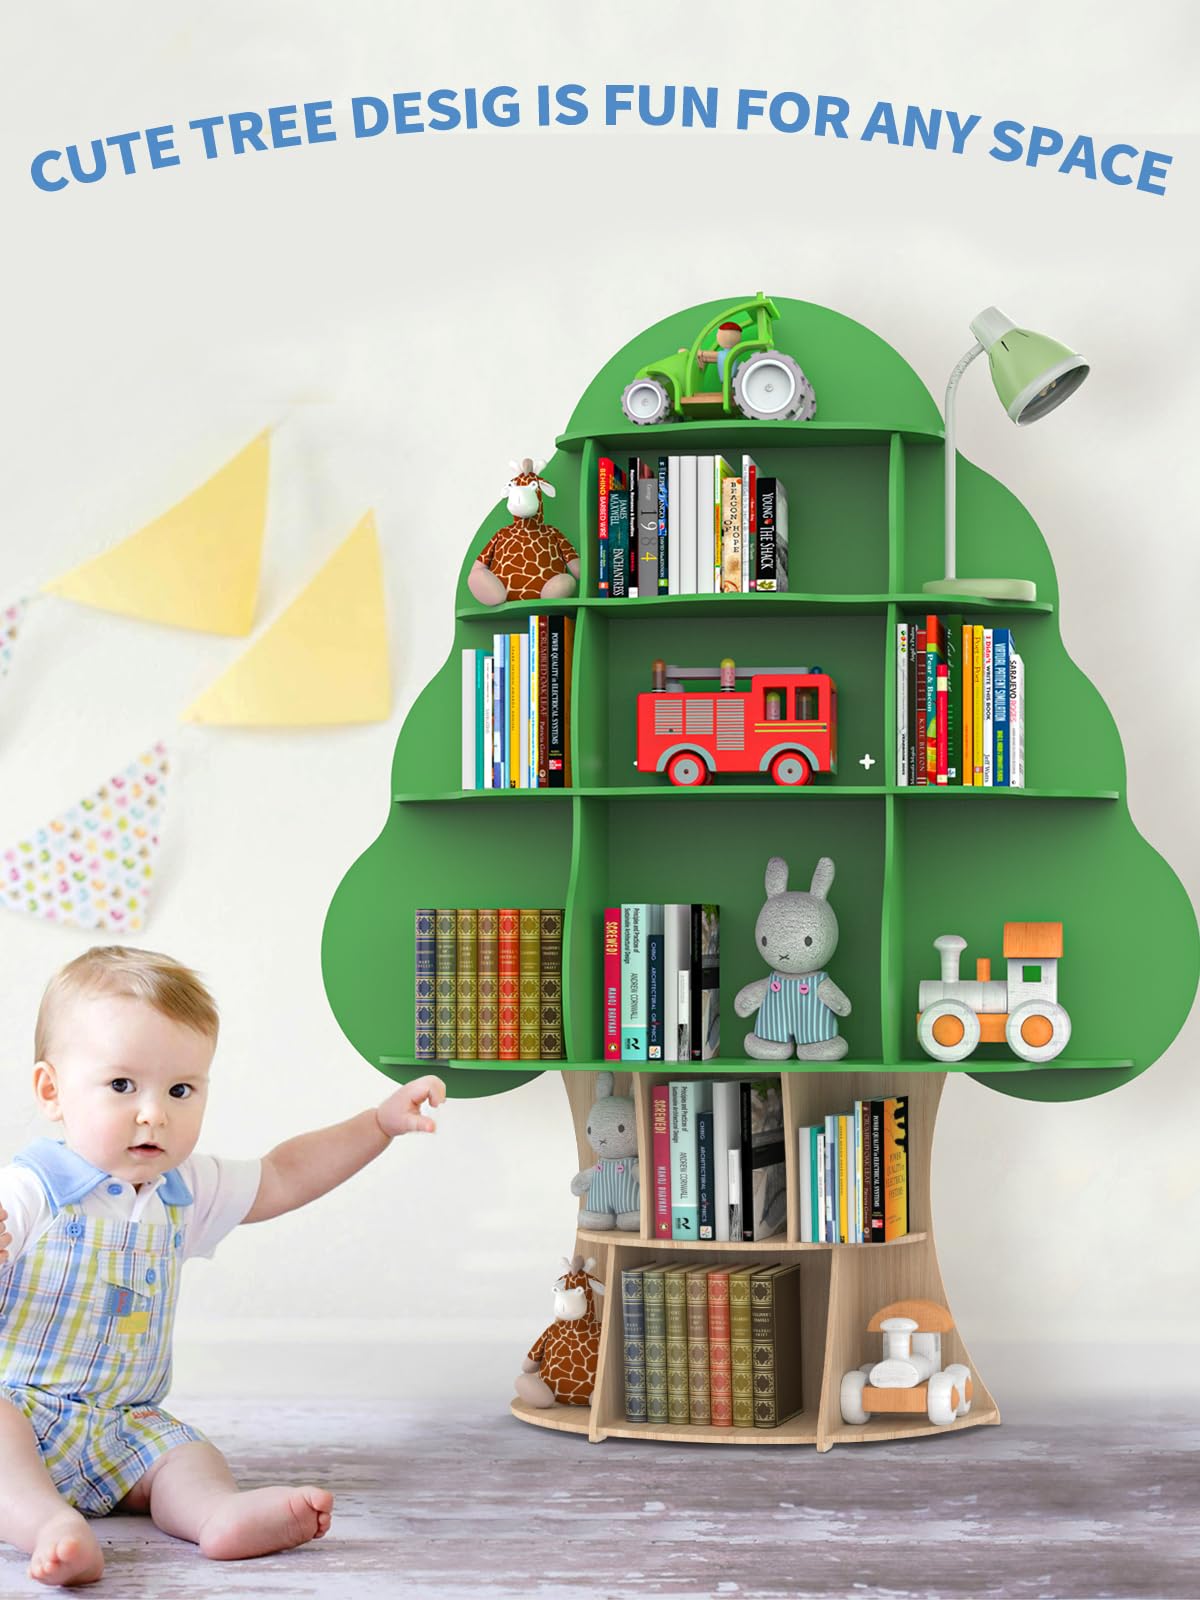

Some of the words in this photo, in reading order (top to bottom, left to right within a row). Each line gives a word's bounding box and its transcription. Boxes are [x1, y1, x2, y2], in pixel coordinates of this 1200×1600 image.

[599, 467, 607, 496] BEHIND
[599, 496, 607, 520] BARBED
[610, 493, 619, 526] MAXWELL
[619, 499, 627, 520] JAMES
[762, 492, 774, 519] YOUNG
[599, 520, 607, 538] WIRE
[732, 525, 740, 553] HOPE
[760, 525, 774, 541] THE
[760, 542, 775, 570] SHACK
[613, 548, 624, 597] ENCHANTRESS
[551, 632, 559, 652] POWER
[551, 652, 559, 678] QUALITY
[994, 643, 1006, 667] VIRTUAL
[927, 675, 934, 686] &
[994, 667, 1006, 689] PATIENT
[551, 683, 559, 718] ELECTRICAL
[994, 689, 1006, 722] SIMULATION
[551, 718, 559, 745] SYSTEMS
[983, 753, 991, 765] Jeff
[679, 1152, 688, 1173] ANDREW
